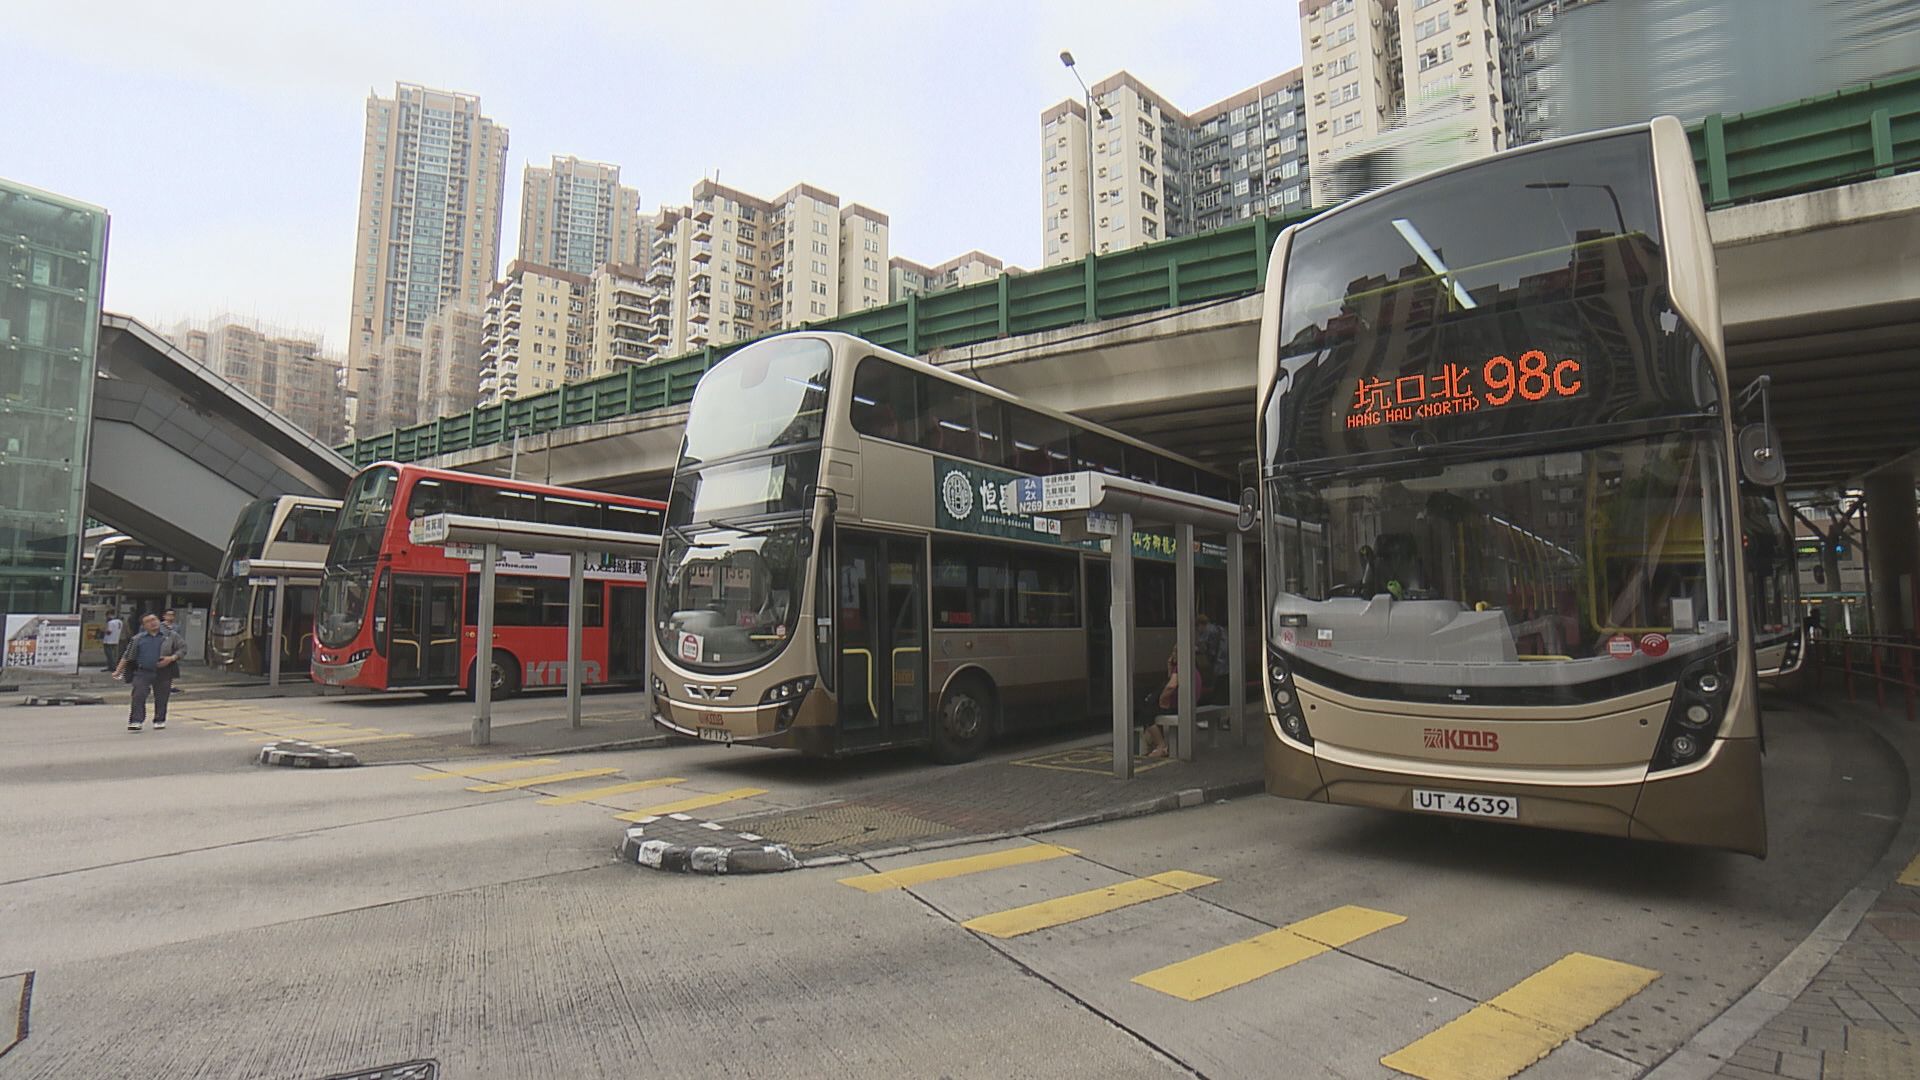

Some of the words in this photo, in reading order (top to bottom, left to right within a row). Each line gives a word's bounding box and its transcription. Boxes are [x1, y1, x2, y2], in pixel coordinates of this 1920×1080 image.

[1354, 363, 1472, 412] 坑口北
[1346, 410, 1381, 428] HANG
[1385, 406, 1412, 423] HAU
[1024, 479, 1037, 490] 2A
[1019, 500, 1043, 512] N269
[1025, 491, 1037, 501] 2X
[1444, 728, 1499, 752] KMB
[1419, 792, 1445, 809] UT
[1453, 796, 1510, 815] 4639
